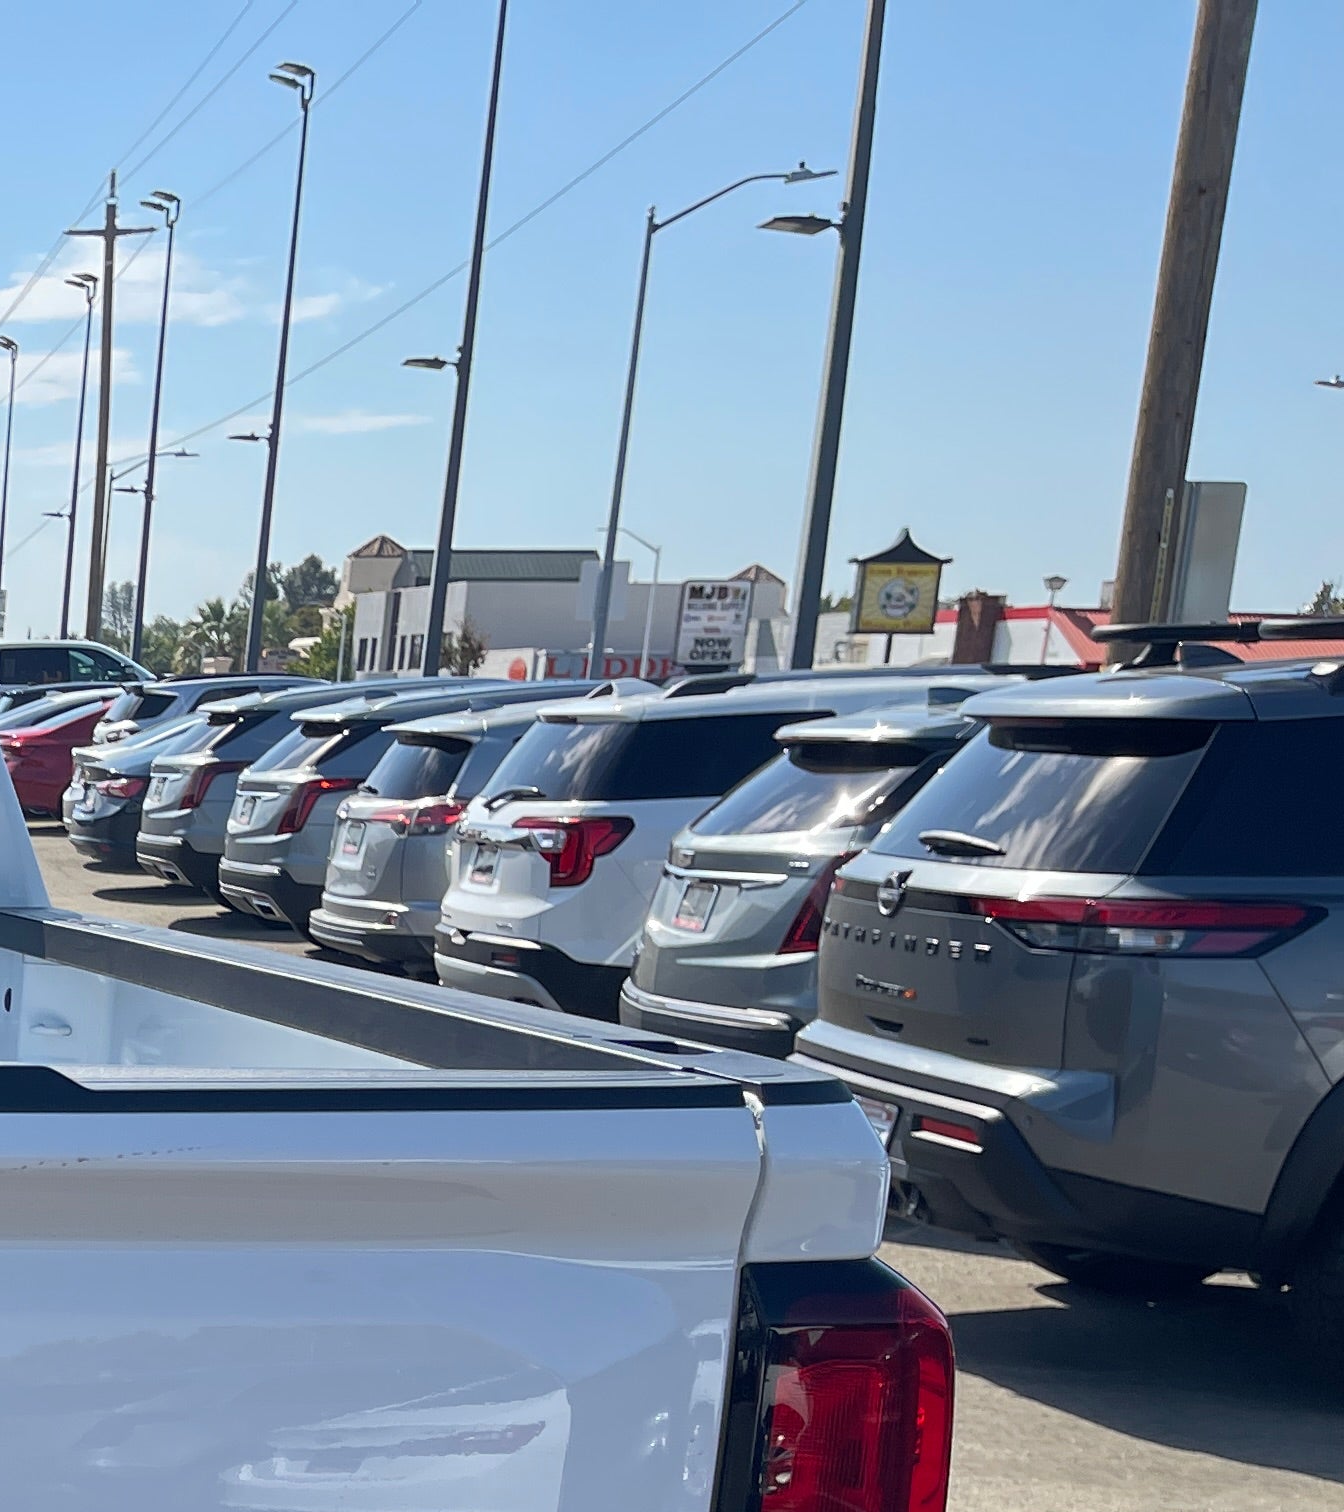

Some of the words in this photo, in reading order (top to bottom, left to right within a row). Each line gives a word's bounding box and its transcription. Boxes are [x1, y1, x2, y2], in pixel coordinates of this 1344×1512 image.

[695, 638, 732, 648] NOW
[690, 650, 732, 661] OPEN
[824, 917, 993, 963] PATHFINDER
